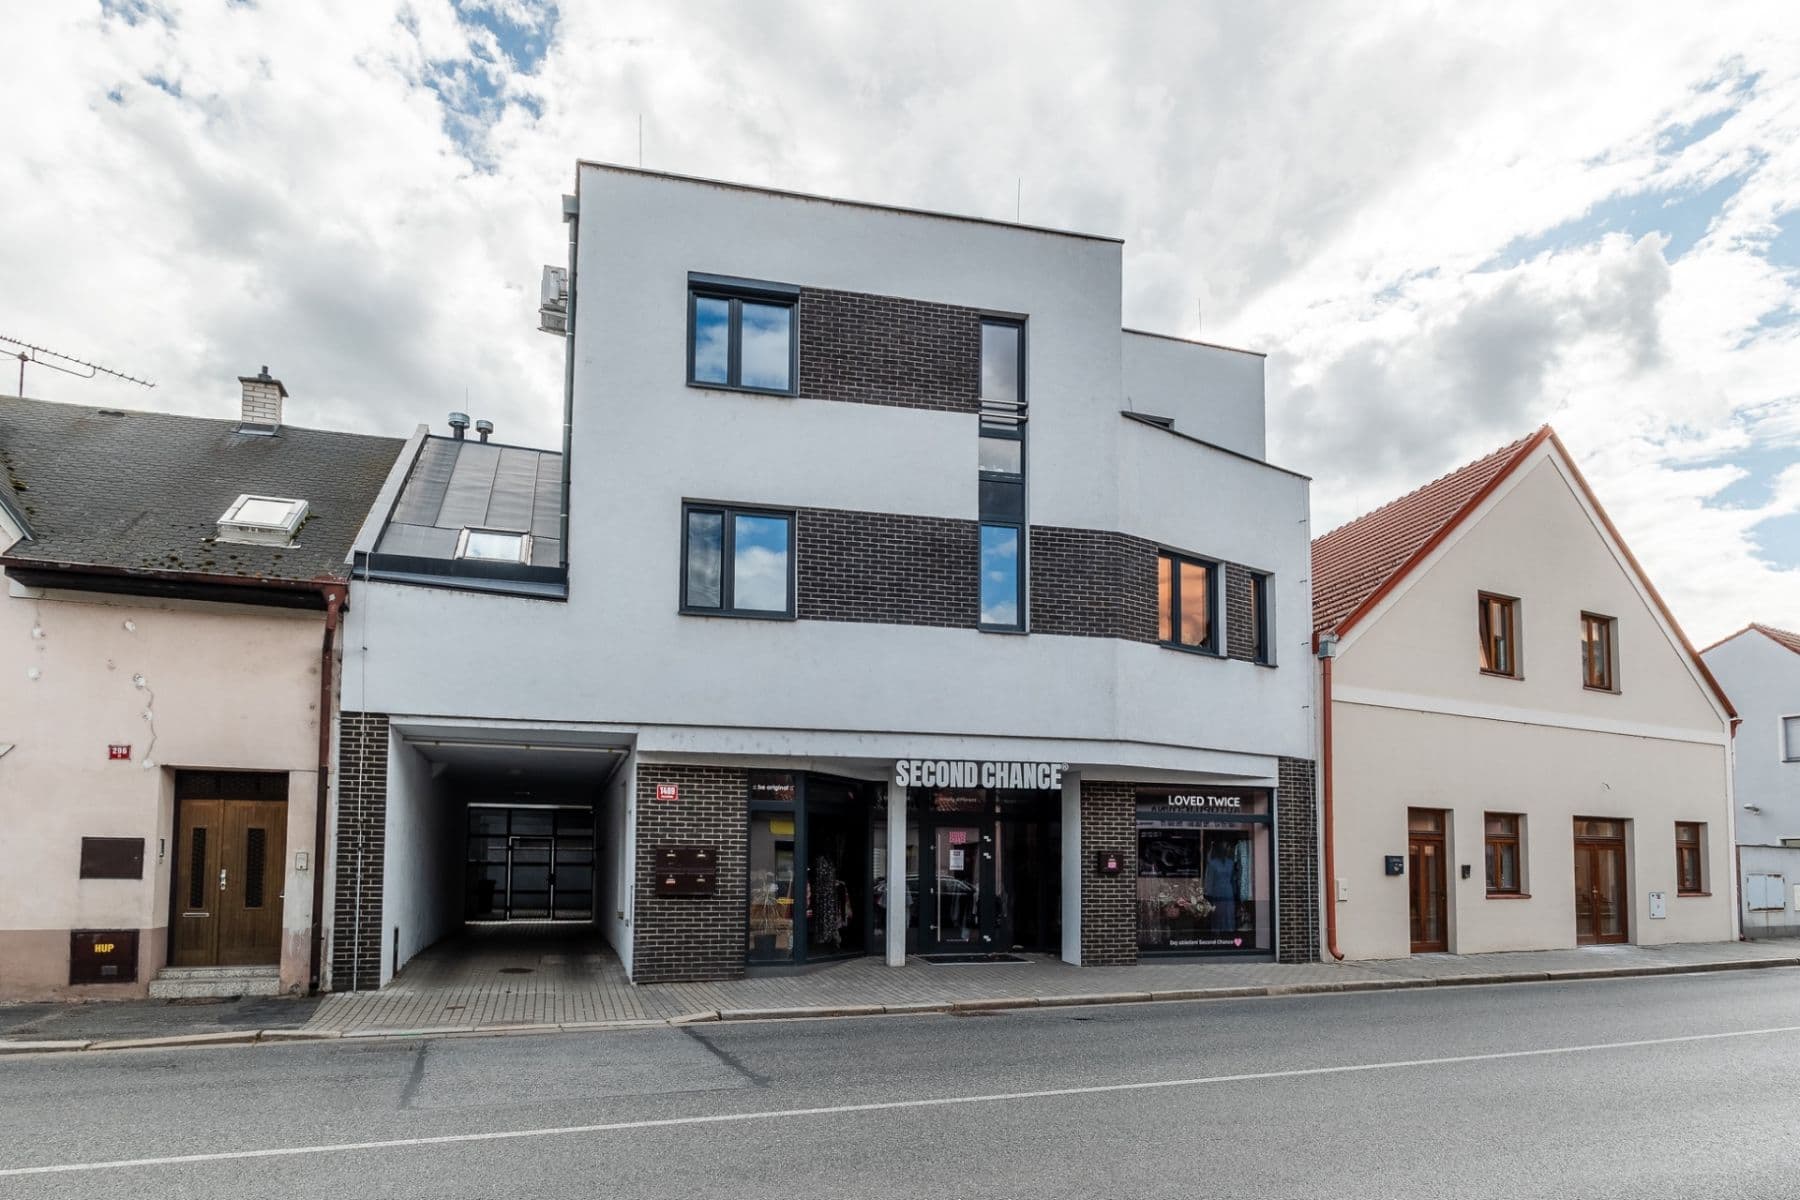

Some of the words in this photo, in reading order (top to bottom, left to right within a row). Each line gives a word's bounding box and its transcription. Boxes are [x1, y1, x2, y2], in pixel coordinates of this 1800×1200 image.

[895, 760, 978, 788] SECOND
[1168, 795, 1204, 807] LOVED
[1208, 796, 1240, 808] TWICE
[94, 943, 115, 953] HUP
